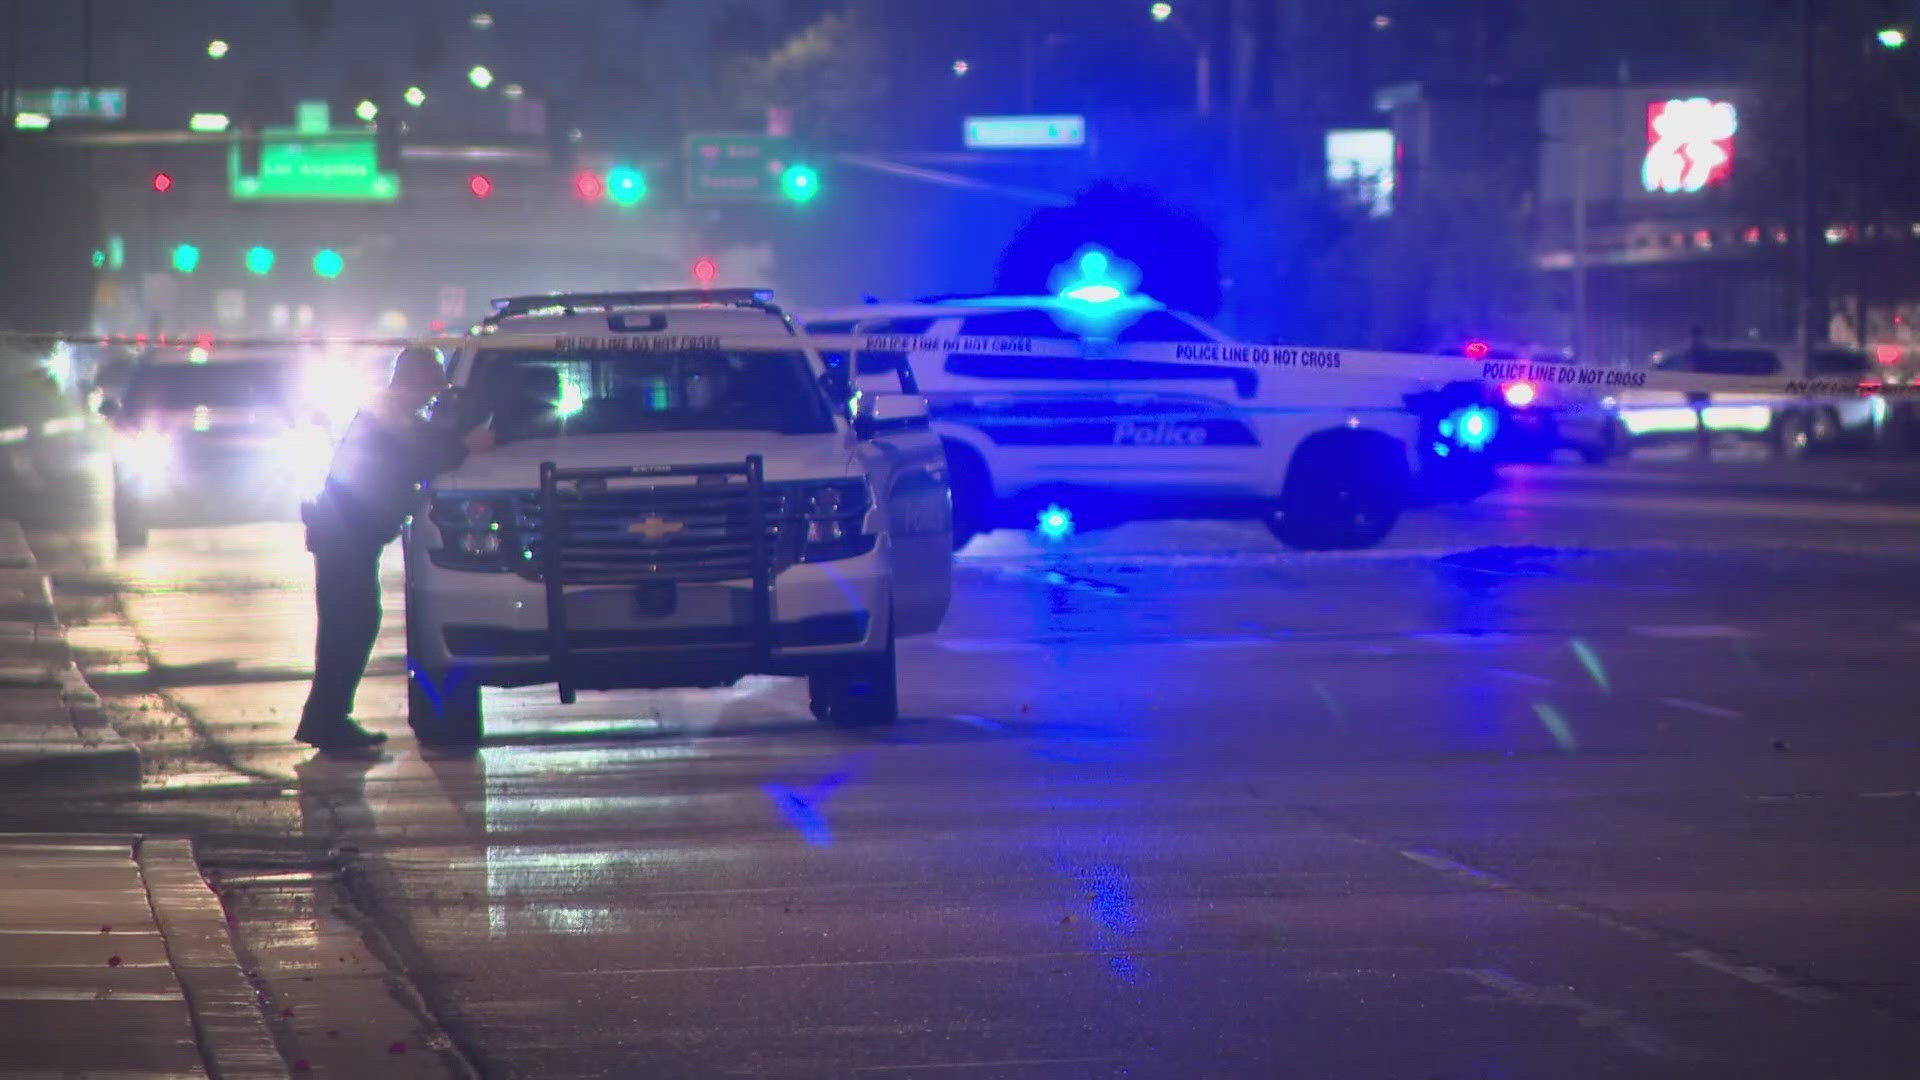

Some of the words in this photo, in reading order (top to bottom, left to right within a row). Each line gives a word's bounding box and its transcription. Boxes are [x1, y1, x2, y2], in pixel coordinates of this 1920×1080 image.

[632, 336, 649, 351] DO
[653, 336, 677, 351] NOT
[867, 336, 907, 351] POLICE
[944, 337, 960, 351] DO
[963, 337, 987, 352] NOT
[1176, 344, 1219, 361] POLICE
[1222, 346, 1249, 362] LINE
[1253, 348, 1270, 364] DO
[1273, 349, 1298, 366] NOT
[1301, 351, 1341, 368] CROSS
[1482, 362, 1527, 379] POLICE
[1528, 365, 1556, 382] LINE
[1557, 368, 1575, 383] DO
[1577, 369, 1604, 384] NOT
[1606, 371, 1647, 387] CROSS
[1112, 421, 1207, 446] Police
